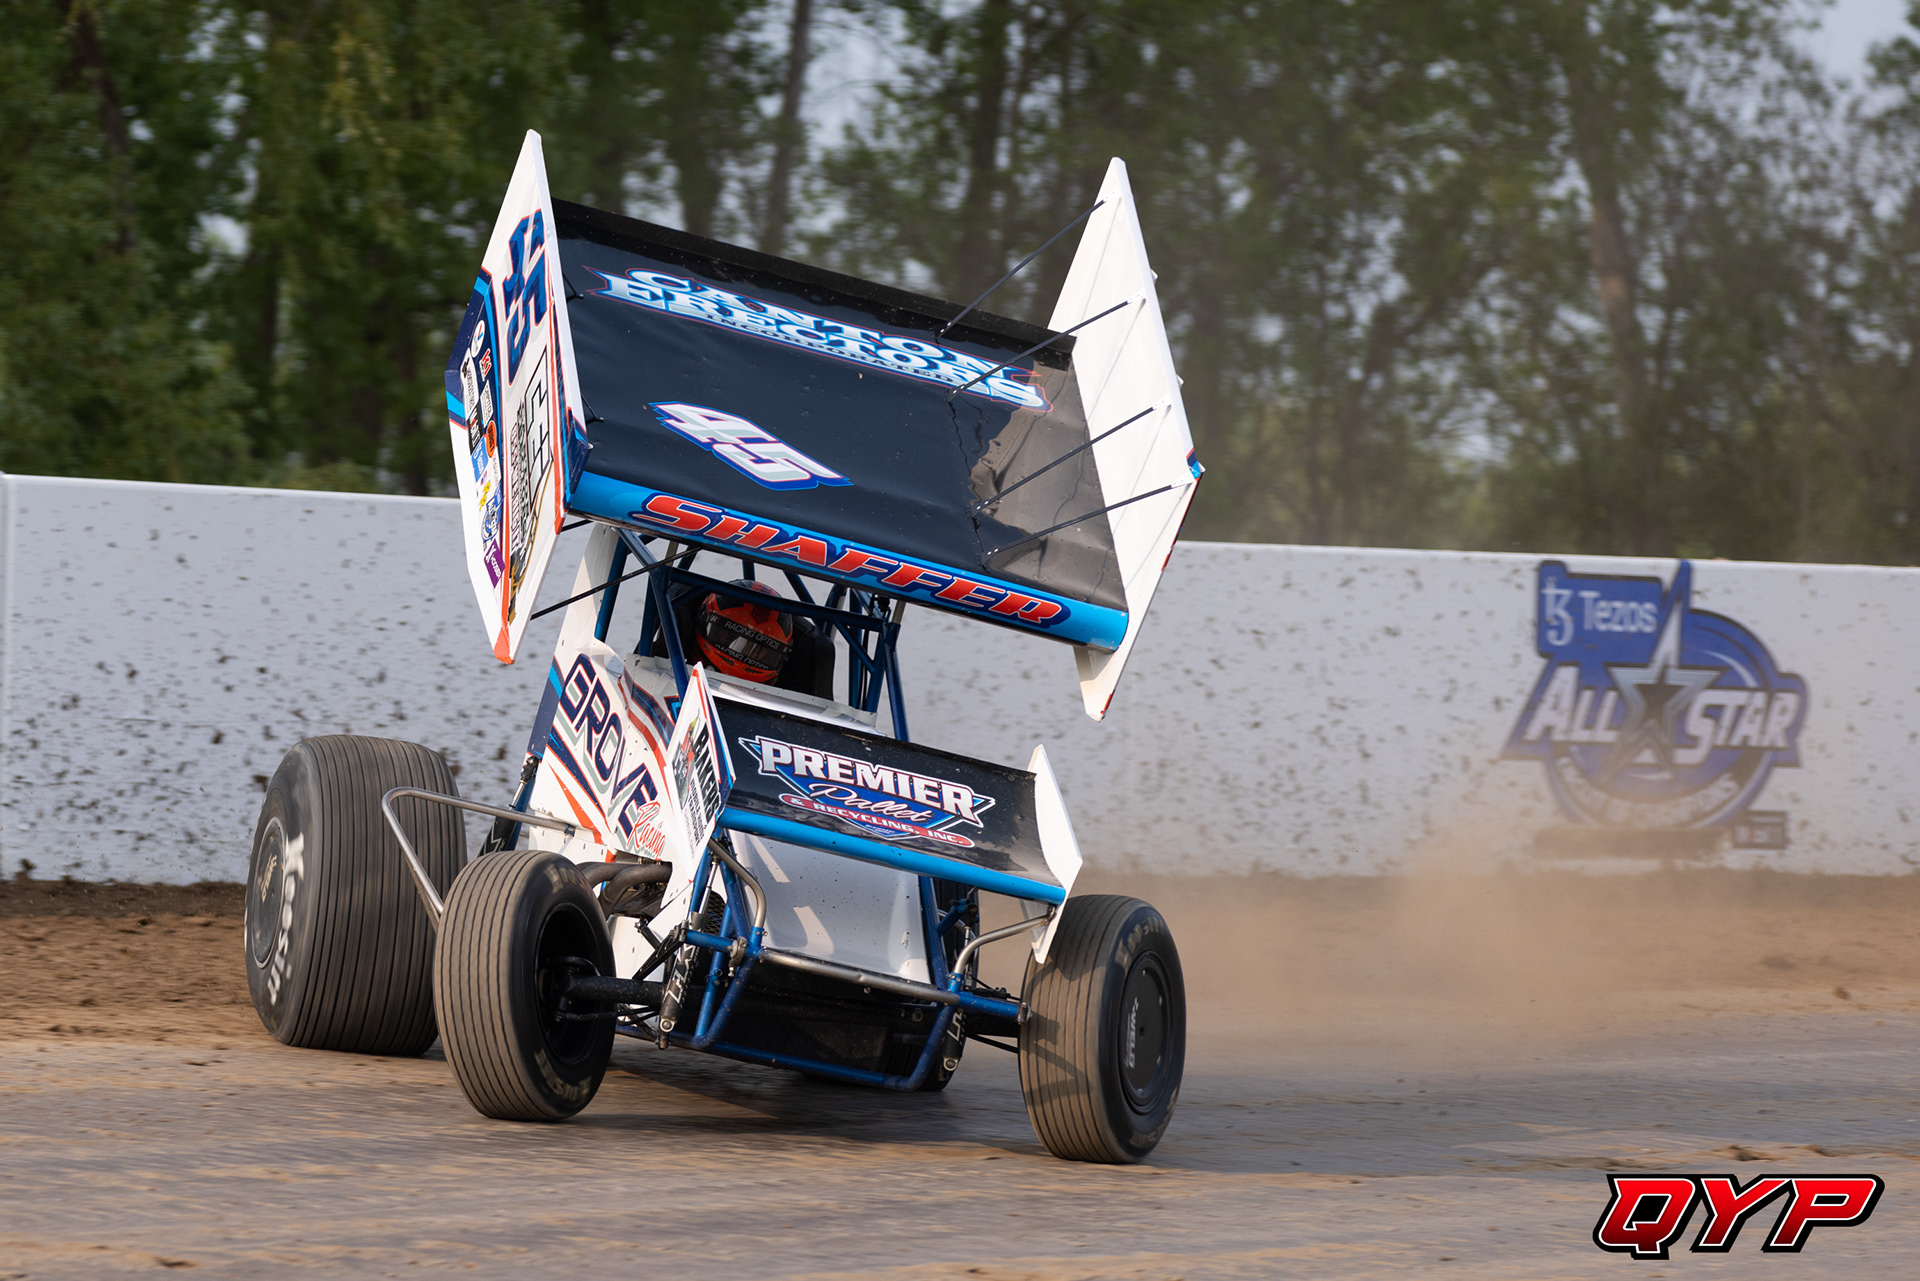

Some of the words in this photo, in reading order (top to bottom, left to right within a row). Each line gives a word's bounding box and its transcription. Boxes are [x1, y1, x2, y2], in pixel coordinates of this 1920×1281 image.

[502, 208, 547, 386] 45
[629, 269, 1029, 378] CANTON
[600, 272, 1047, 408] ERECTORS
[704, 313, 955, 384] INCORPORATED
[653, 403, 846, 483] 45
[632, 495, 1063, 624] SHAFFER
[724, 620, 756, 640] RACING
[756, 634, 780, 650] OPTICS
[1578, 590, 1658, 633] Tezos
[559, 653, 659, 840] GROVE
[693, 721, 720, 825] BAKERS
[759, 739, 980, 826] PREMIER
[627, 801, 666, 860] Racing
[808, 783, 935, 823] Pallet
[812, 802, 922, 835] RECYCLING,
[927, 830, 964, 845] INC.
